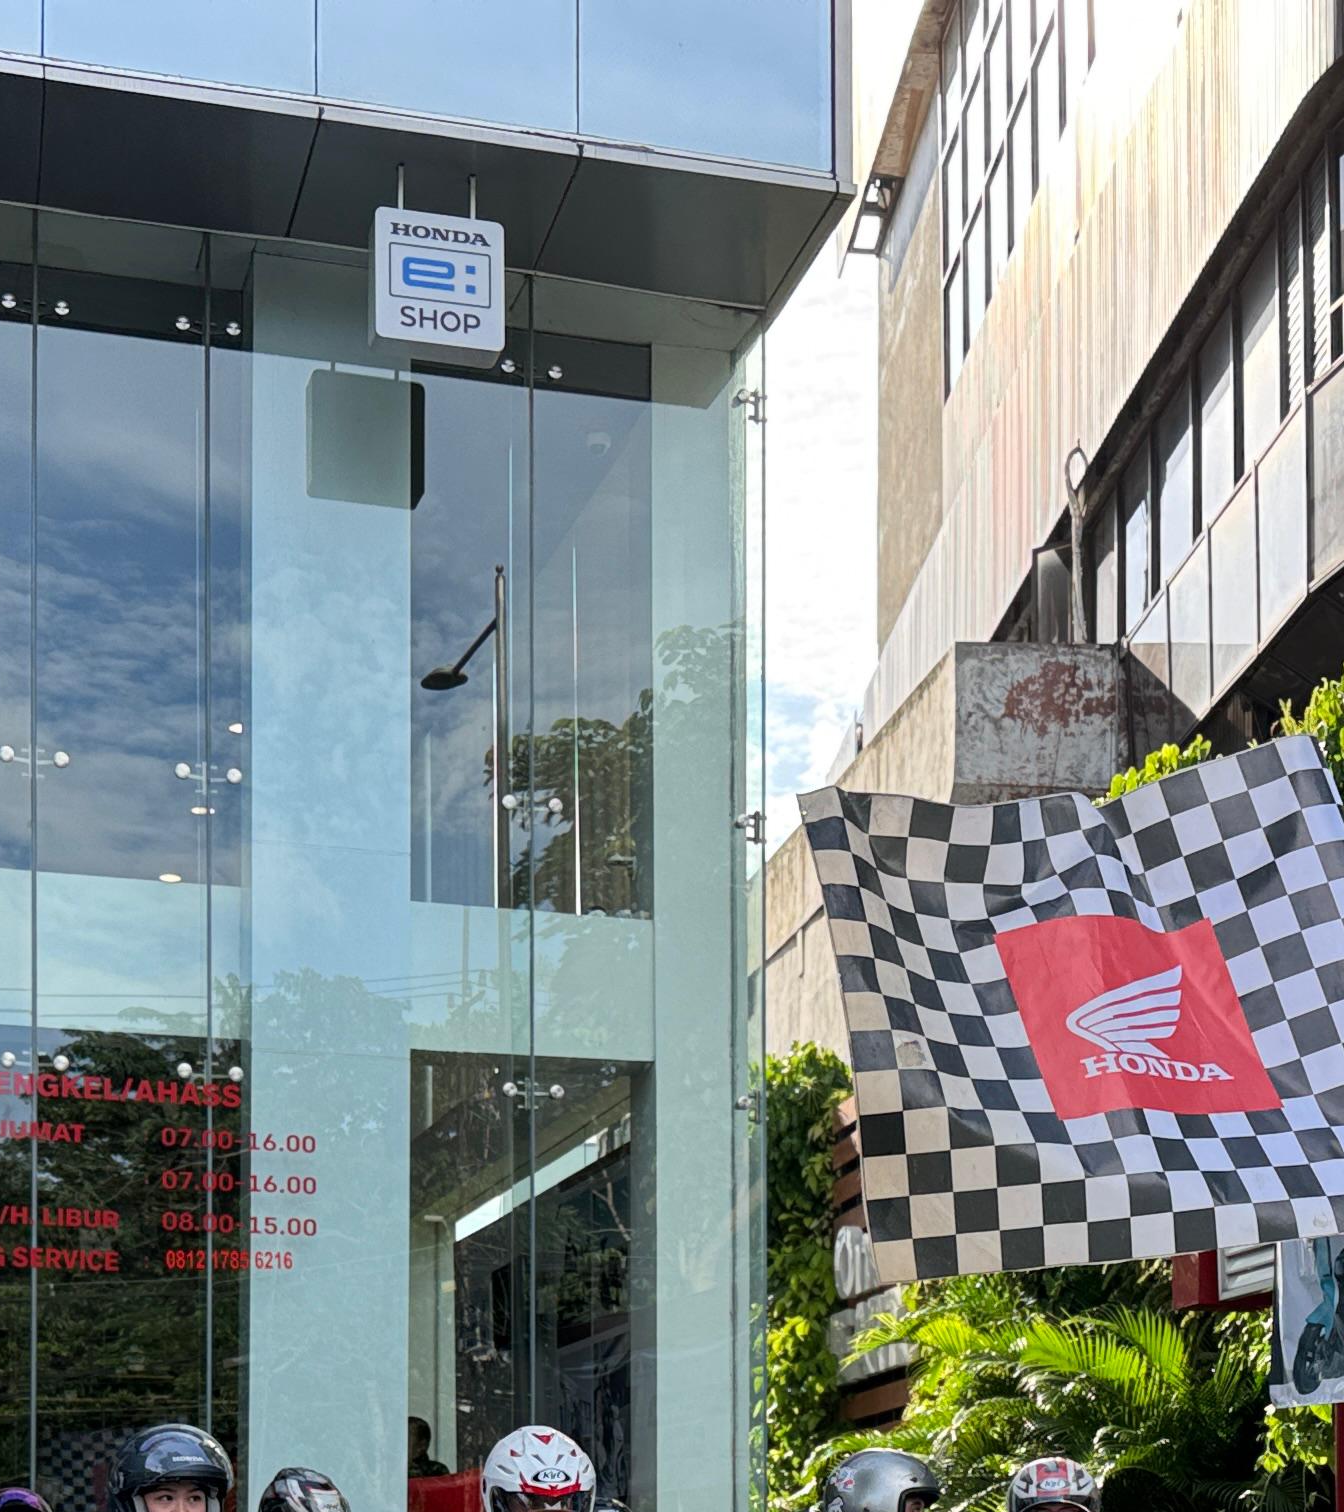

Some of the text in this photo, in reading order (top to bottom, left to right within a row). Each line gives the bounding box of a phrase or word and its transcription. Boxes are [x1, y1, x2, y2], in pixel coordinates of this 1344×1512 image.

[390, 222, 491, 247] HONDA
[400, 306, 481, 334] SHOP
[1080, 1053, 1234, 1082] HONDA
[161, 1127, 316, 1154] 07.00-16.00
[161, 1169, 317, 1195] 07.00-16.00
[42, 1208, 120, 1231] LIBUR
[161, 1211, 317, 1237] 08.00-15.00
[12, 1245, 120, 1272] SERVICE
[165, 1250, 205, 1270] 0812
[255, 1251, 294, 1270] 6216
